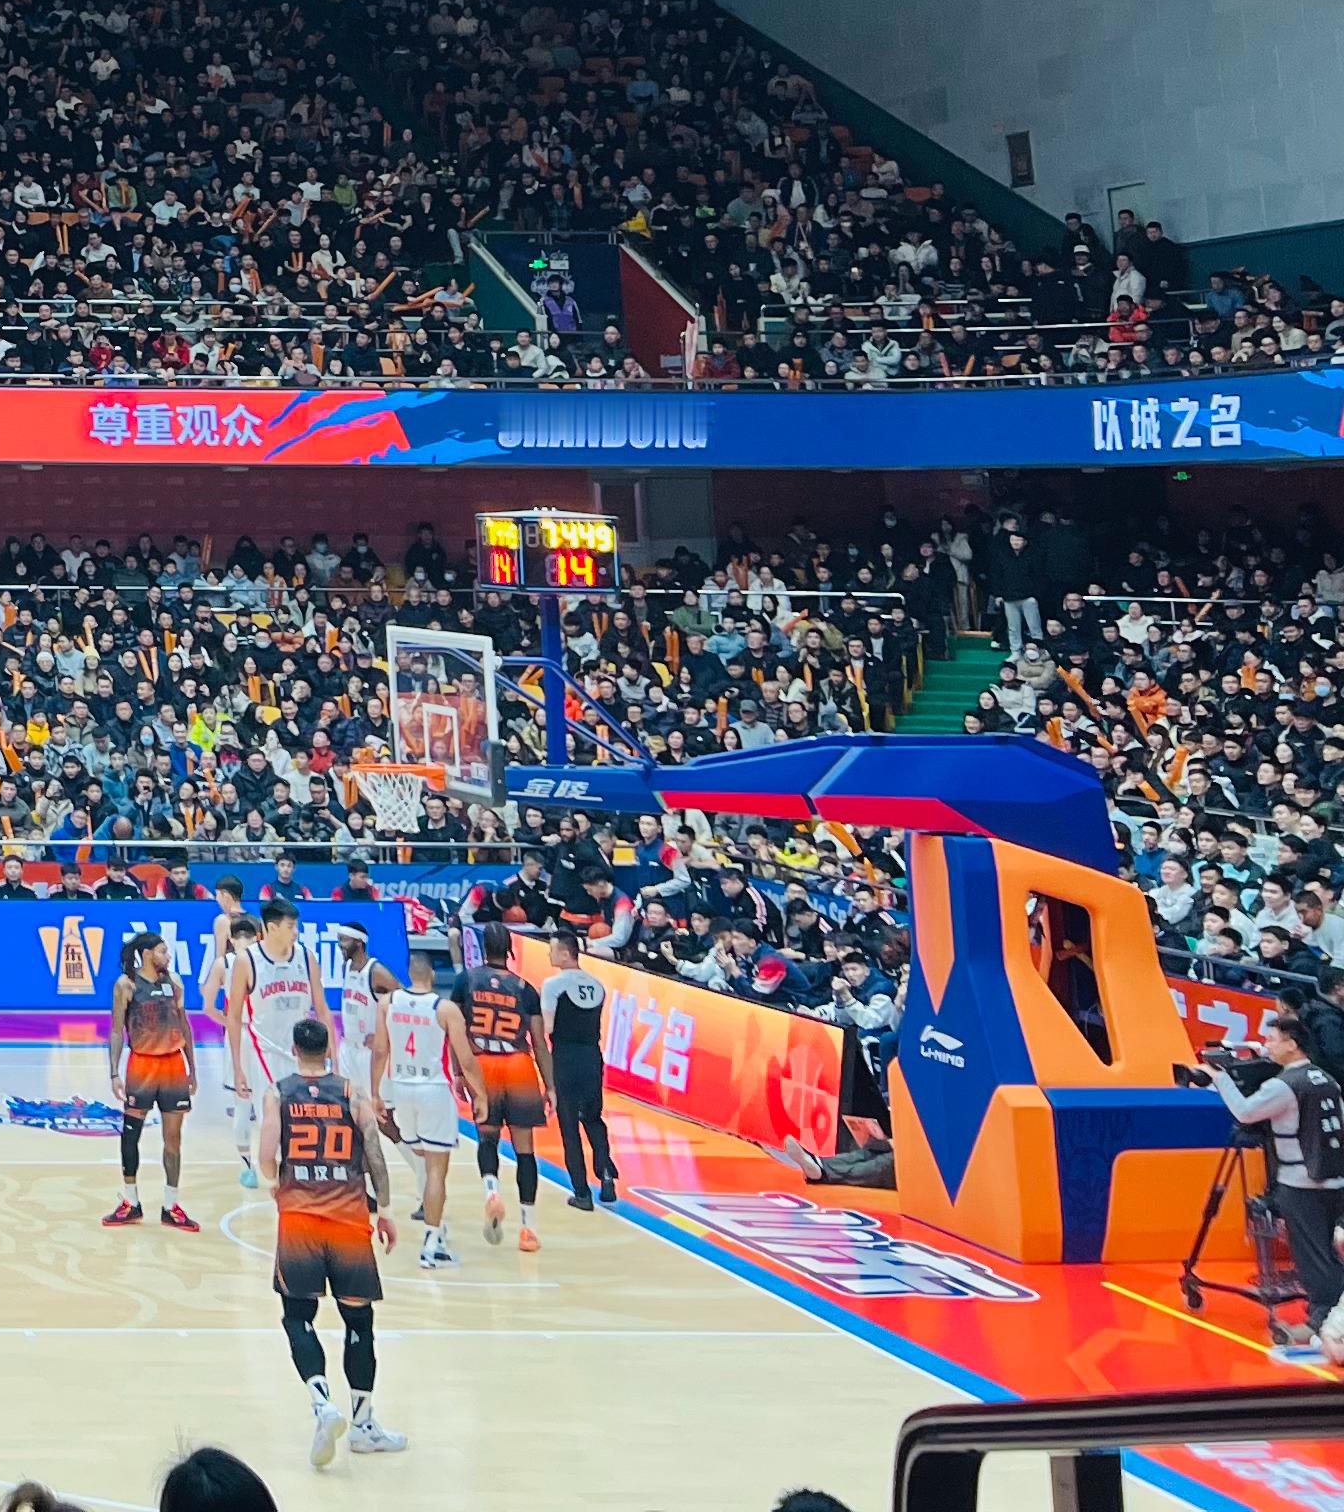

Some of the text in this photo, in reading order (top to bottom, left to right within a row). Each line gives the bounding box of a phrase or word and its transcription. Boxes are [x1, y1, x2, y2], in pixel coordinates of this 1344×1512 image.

[89, 403, 263, 447] 尊重观众
[1092, 394, 1243, 451] 以城之名
[556, 554, 597, 587] 14
[523, 779, 590, 800] 金陵
[62, 941, 83, 980] 东鹏
[578, 985, 595, 1001] 57
[469, 1006, 522, 1040] 32
[404, 1031, 416, 1058] 4
[919, 1045, 966, 1069] LI-NING
[288, 1124, 353, 1160] 20
